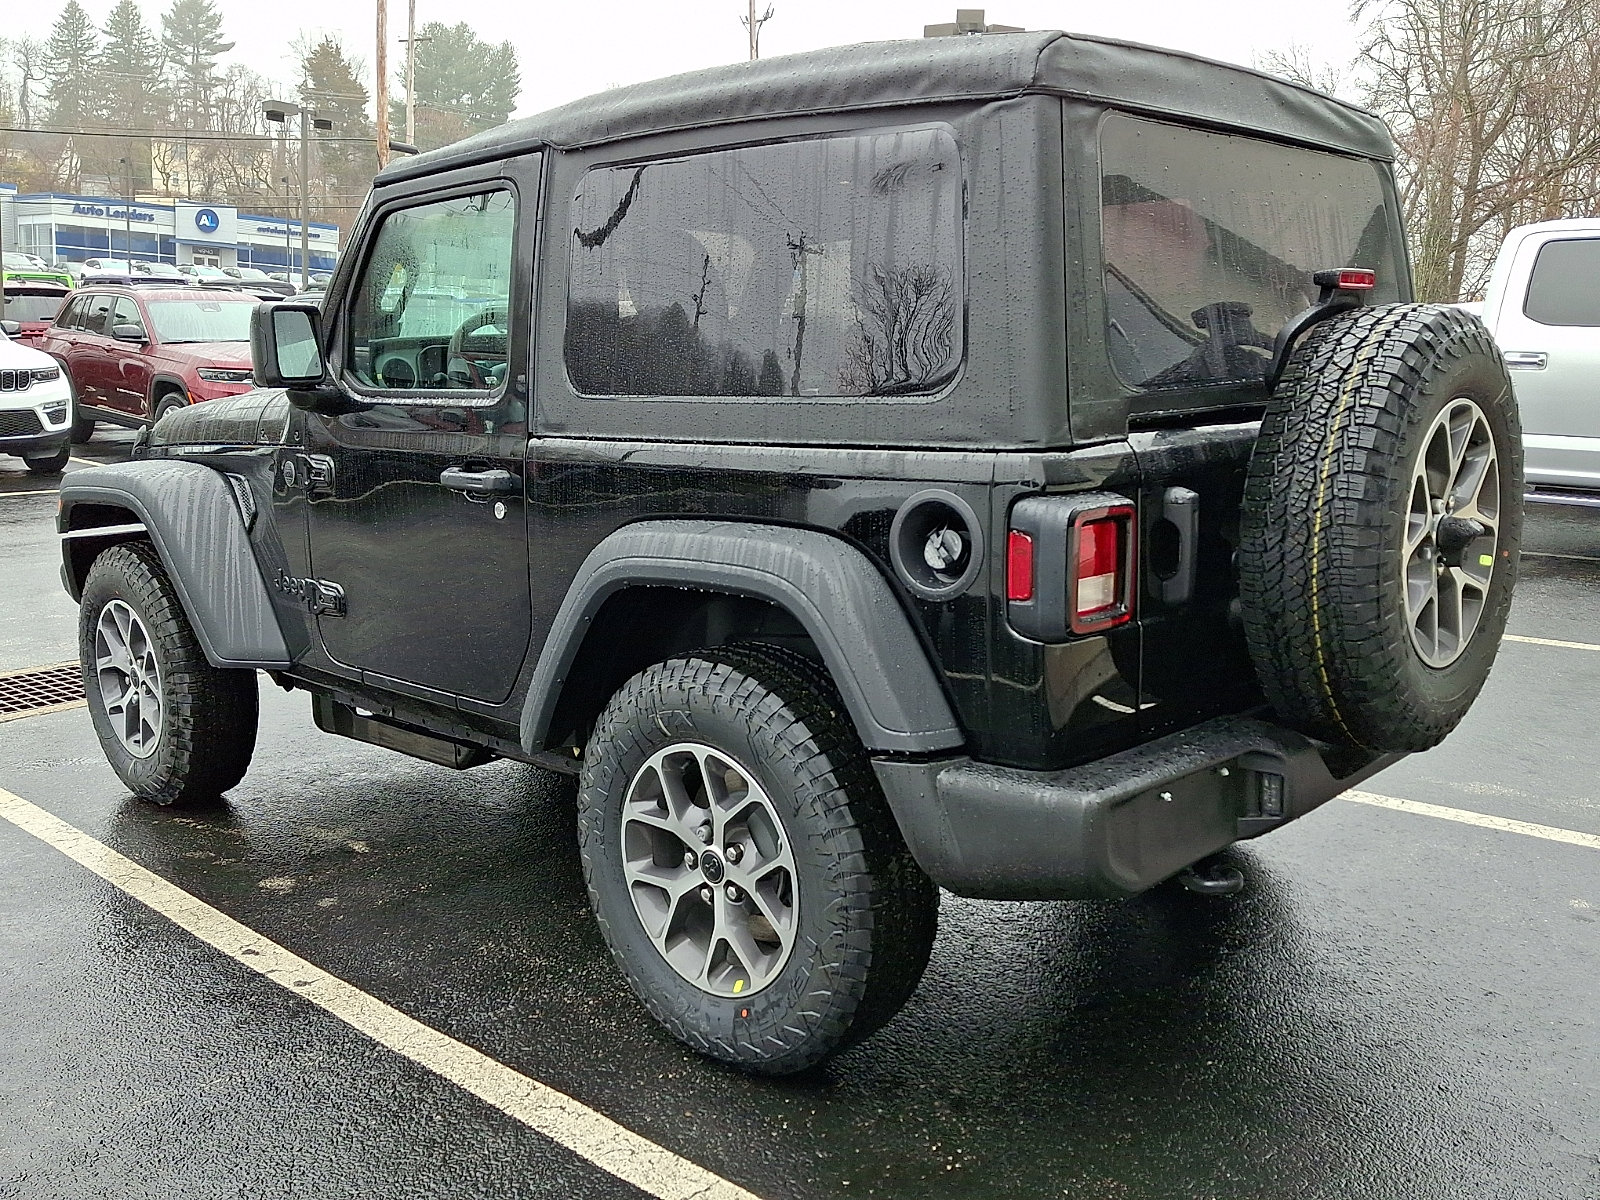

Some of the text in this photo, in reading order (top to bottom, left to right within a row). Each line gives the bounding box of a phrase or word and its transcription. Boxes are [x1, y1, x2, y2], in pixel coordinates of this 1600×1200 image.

[72, 203, 155, 222] Auto Lenders
[199, 214, 216, 227] AL
[256, 226, 321, 239] autolendersom
[273, 567, 307, 602] Jeep
